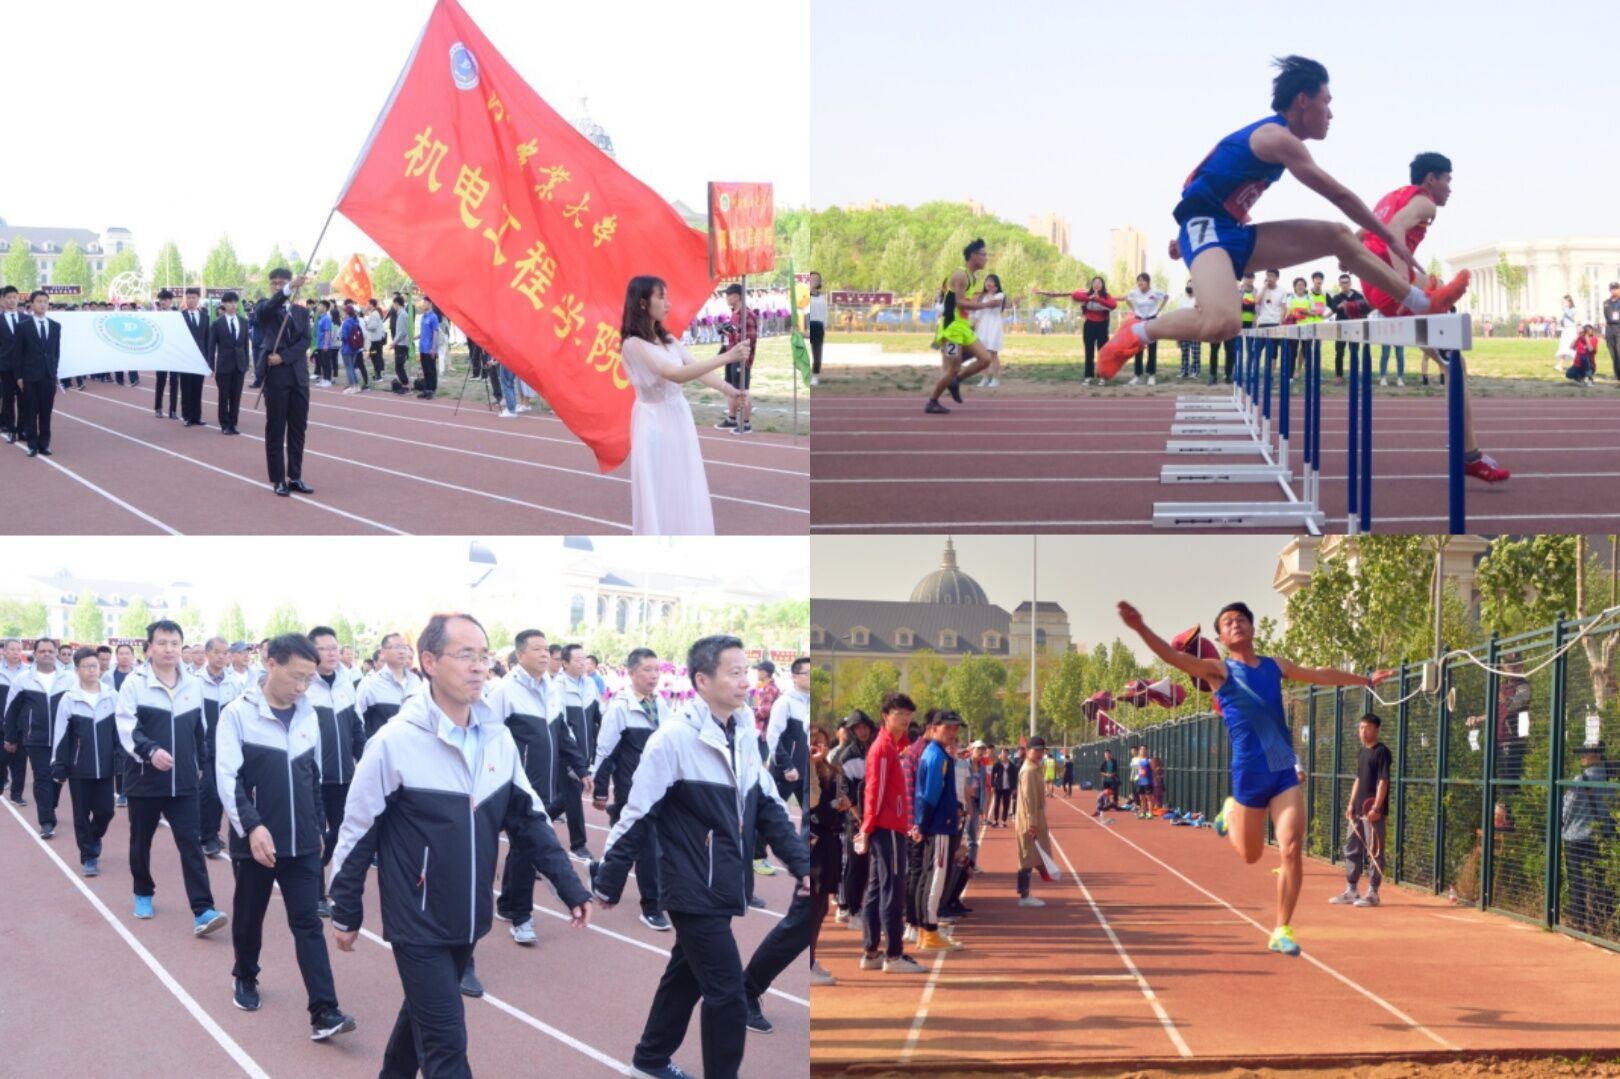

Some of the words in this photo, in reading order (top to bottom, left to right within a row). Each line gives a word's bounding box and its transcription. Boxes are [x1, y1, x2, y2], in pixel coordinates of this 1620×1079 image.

[1190, 219, 1209, 245] 7
[404, 126, 630, 389] 机电工程学院
[947, 343, 957, 356] 2
